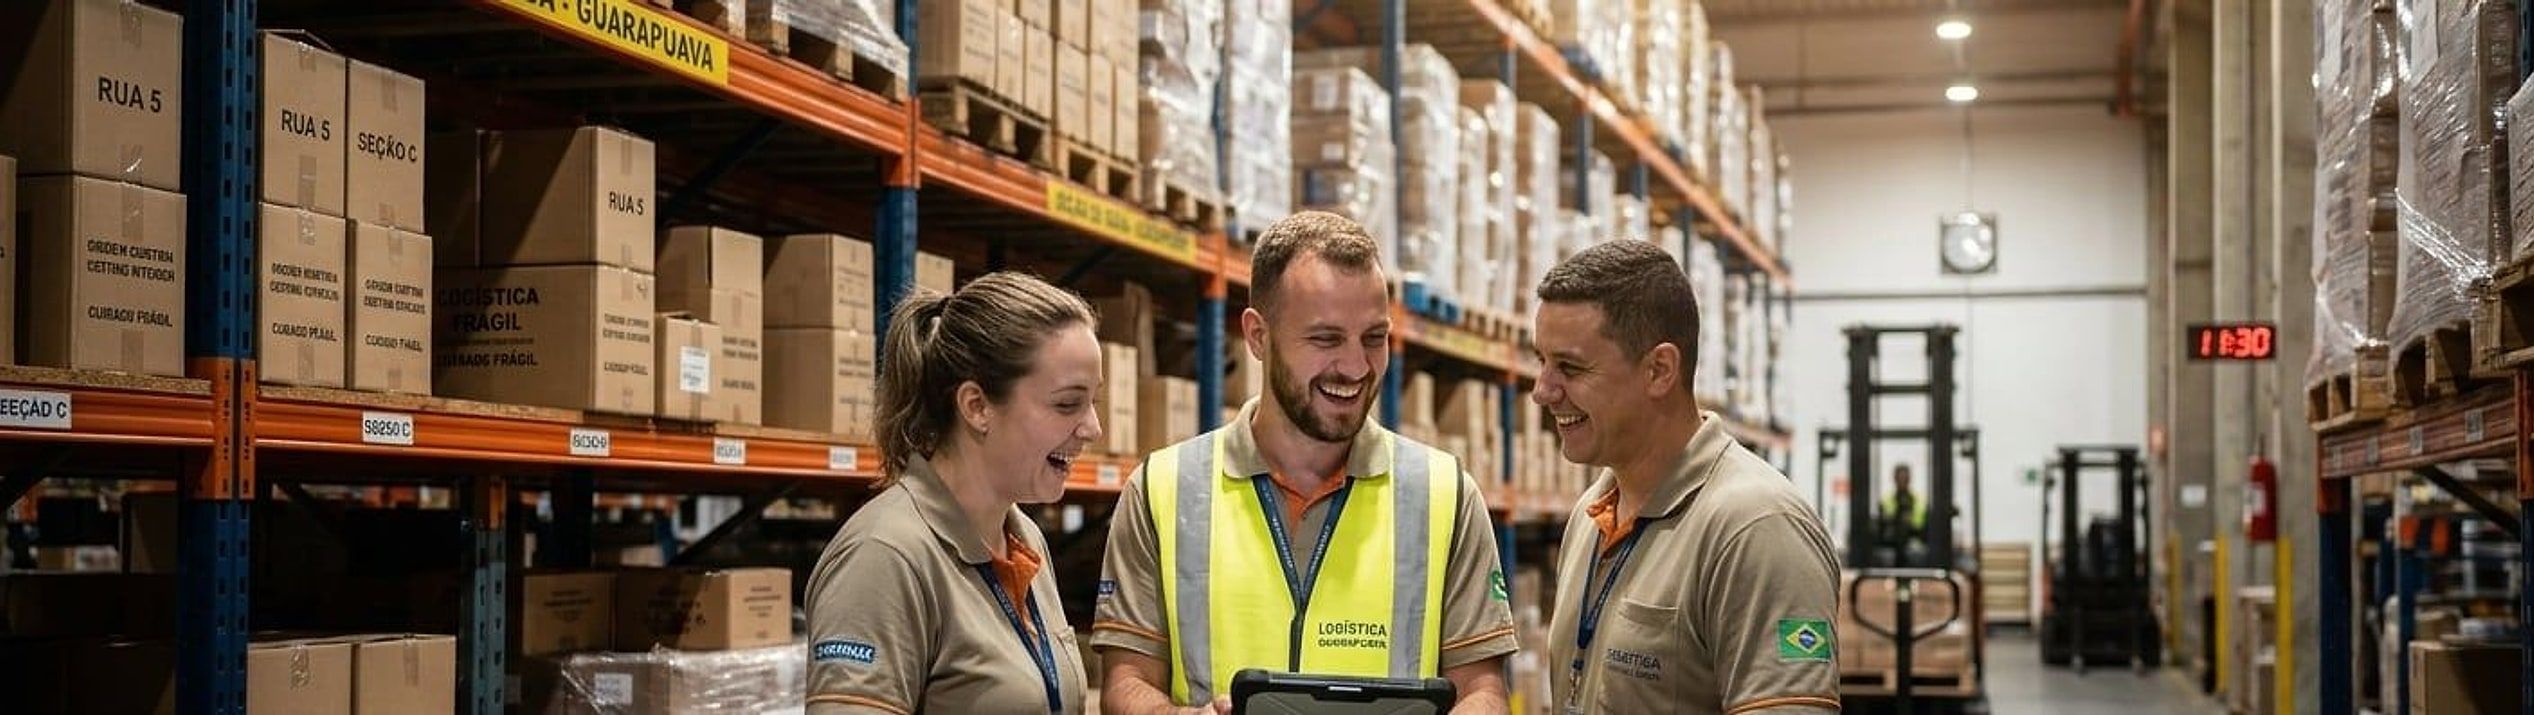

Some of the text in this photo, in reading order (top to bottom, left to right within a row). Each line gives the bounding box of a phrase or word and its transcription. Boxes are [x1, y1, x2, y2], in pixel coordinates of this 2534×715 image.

[577, 0, 714, 72] GUARAPUAVA
[98, 76, 162, 113] RUA 5
[281, 109, 316, 138] RUA
[408, 145, 418, 163] C
[608, 191, 635, 213] RUA
[56, 401, 68, 419] C
